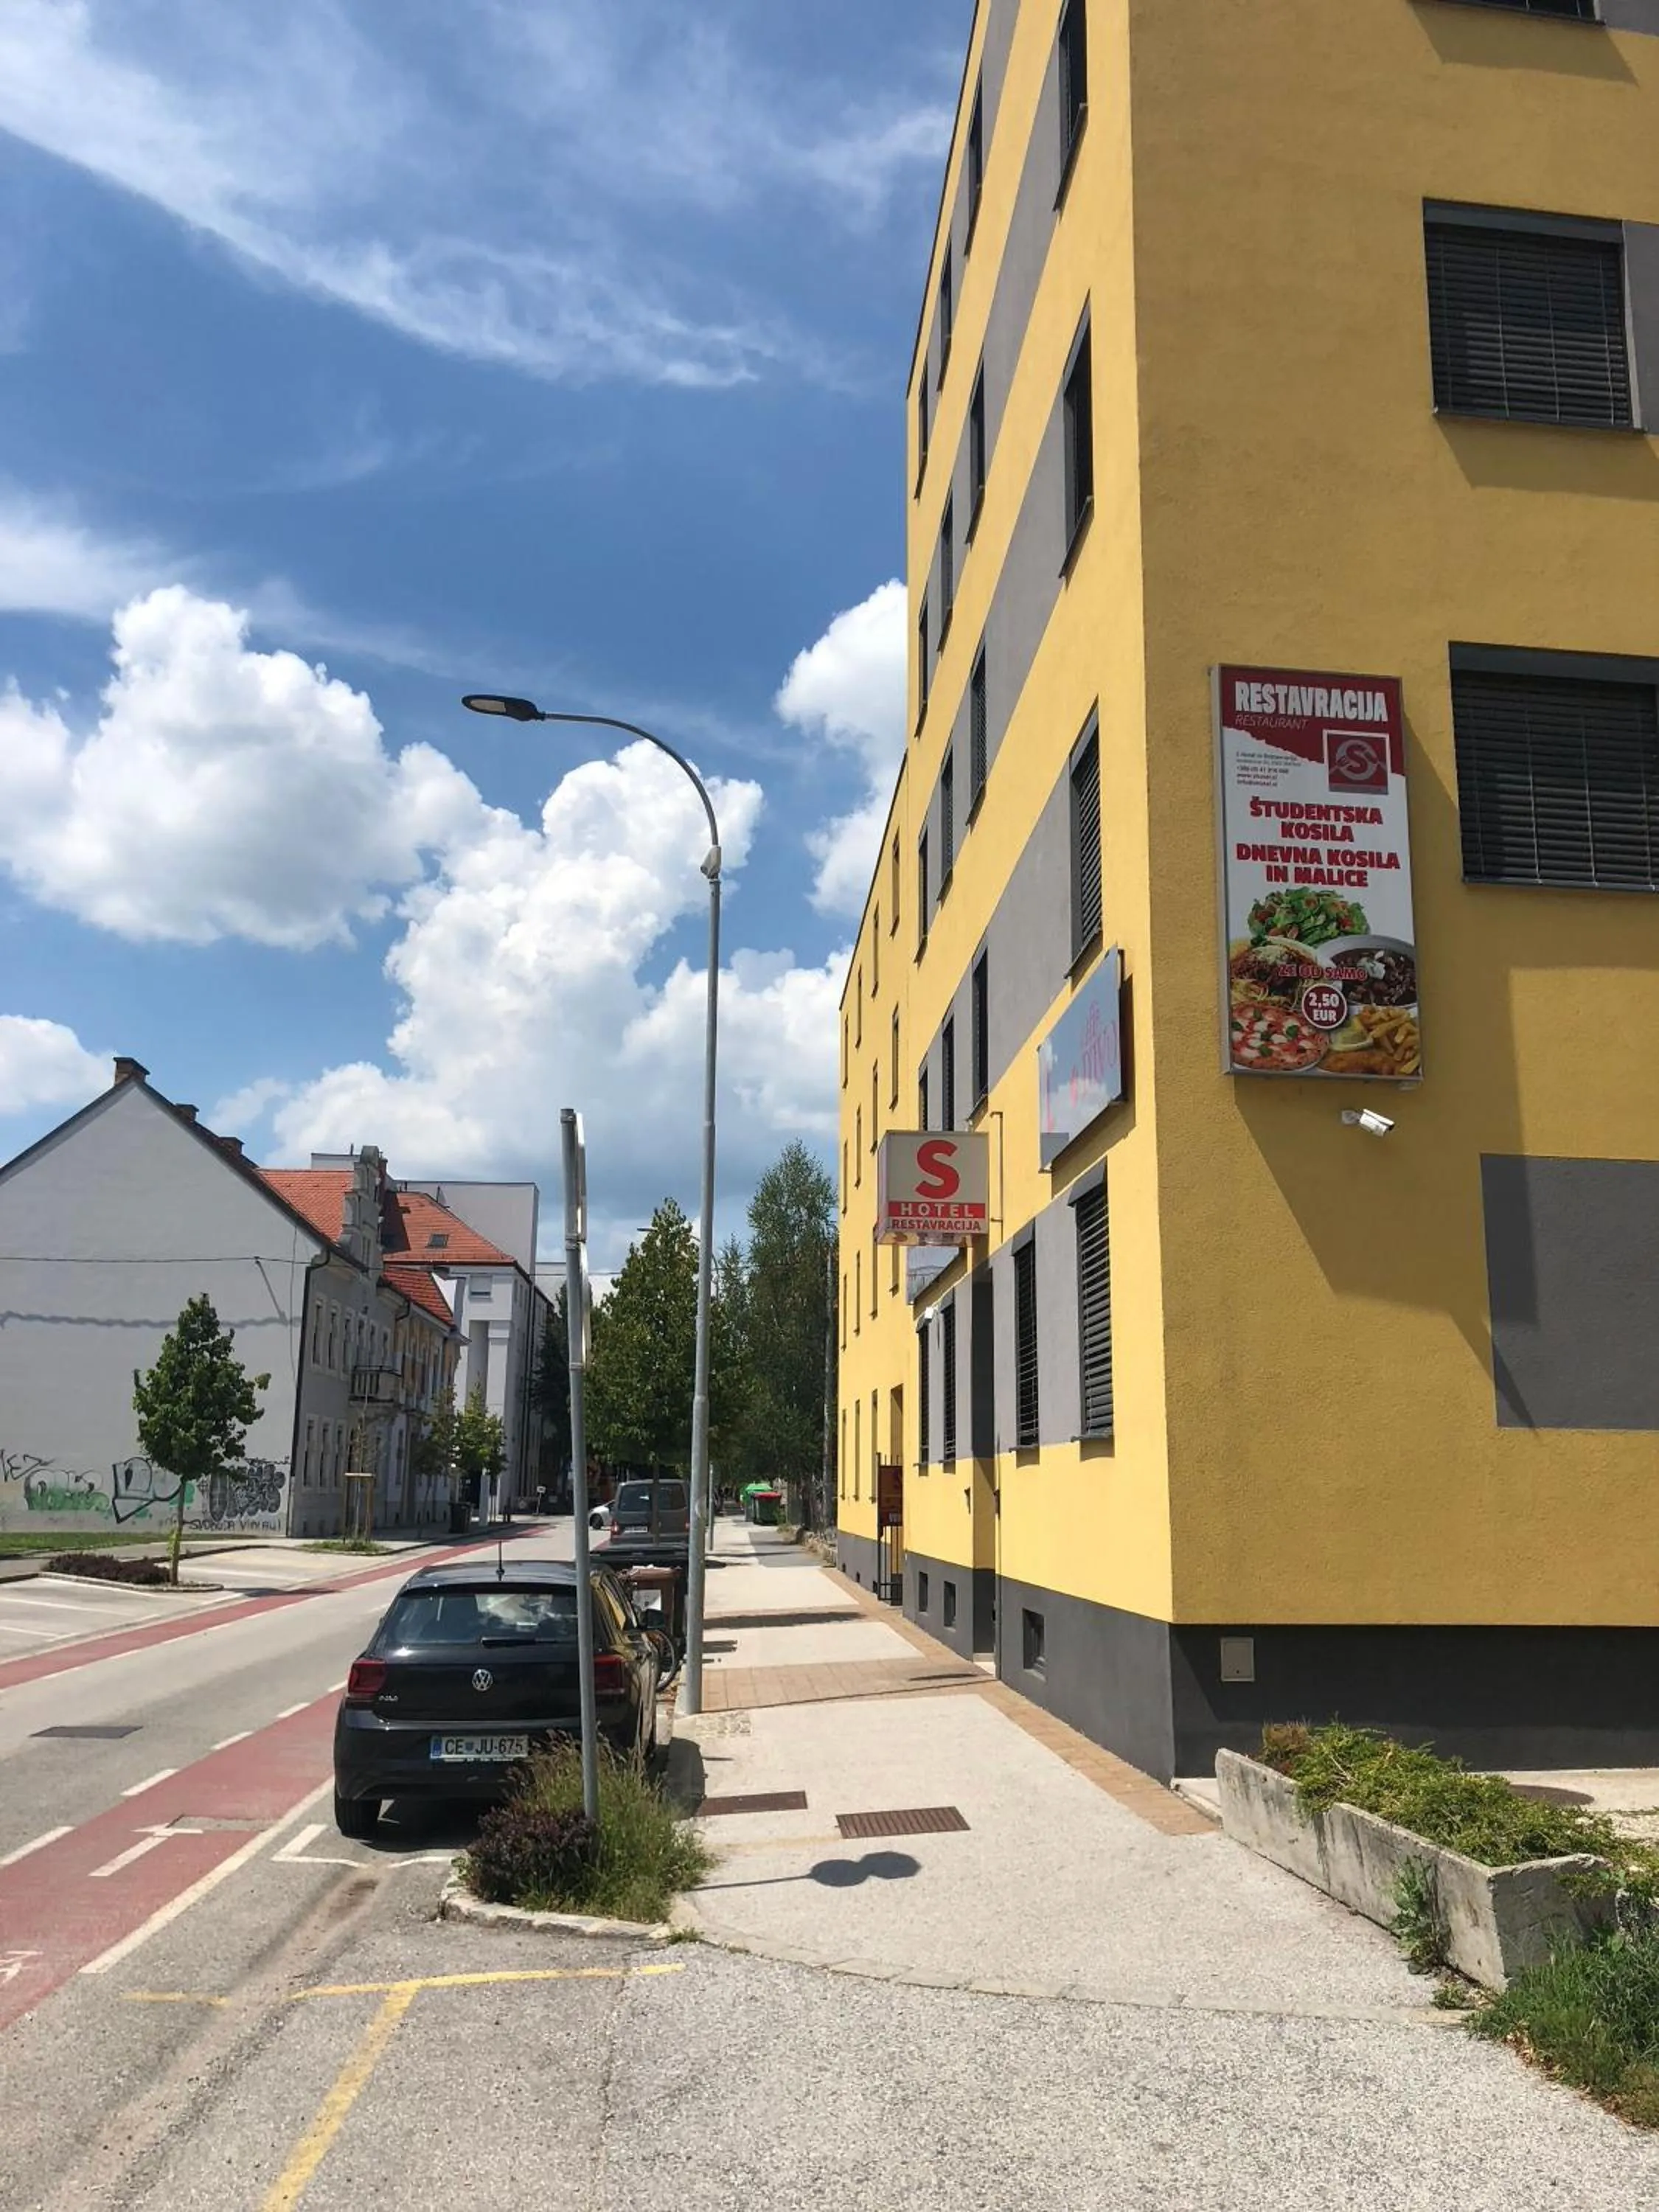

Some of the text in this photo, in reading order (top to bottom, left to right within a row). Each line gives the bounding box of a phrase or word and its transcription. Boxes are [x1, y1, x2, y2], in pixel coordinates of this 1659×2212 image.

[1235, 681, 1388, 722] RESTAVRACIJA
[1235, 714, 1309, 730] RESTAURANT
[1250, 796, 1383, 824] ŠTUDENTSKA
[1281, 821, 1354, 842] KOSILA
[1237, 843, 1401, 869] DNEVNA KOSILA
[1266, 865, 1368, 887] IN MALICE
[1324, 967, 1368, 981] SAMO
[1309, 992, 1340, 1008] 2,50
[1312, 1009, 1337, 1021] EUR
[915, 1139, 961, 1200] S
[901, 1203, 974, 1217] HOTEL
[891, 1219, 981, 1231] RESTAVRACIJA
[445, 1739, 523, 1754] CE JU-675
